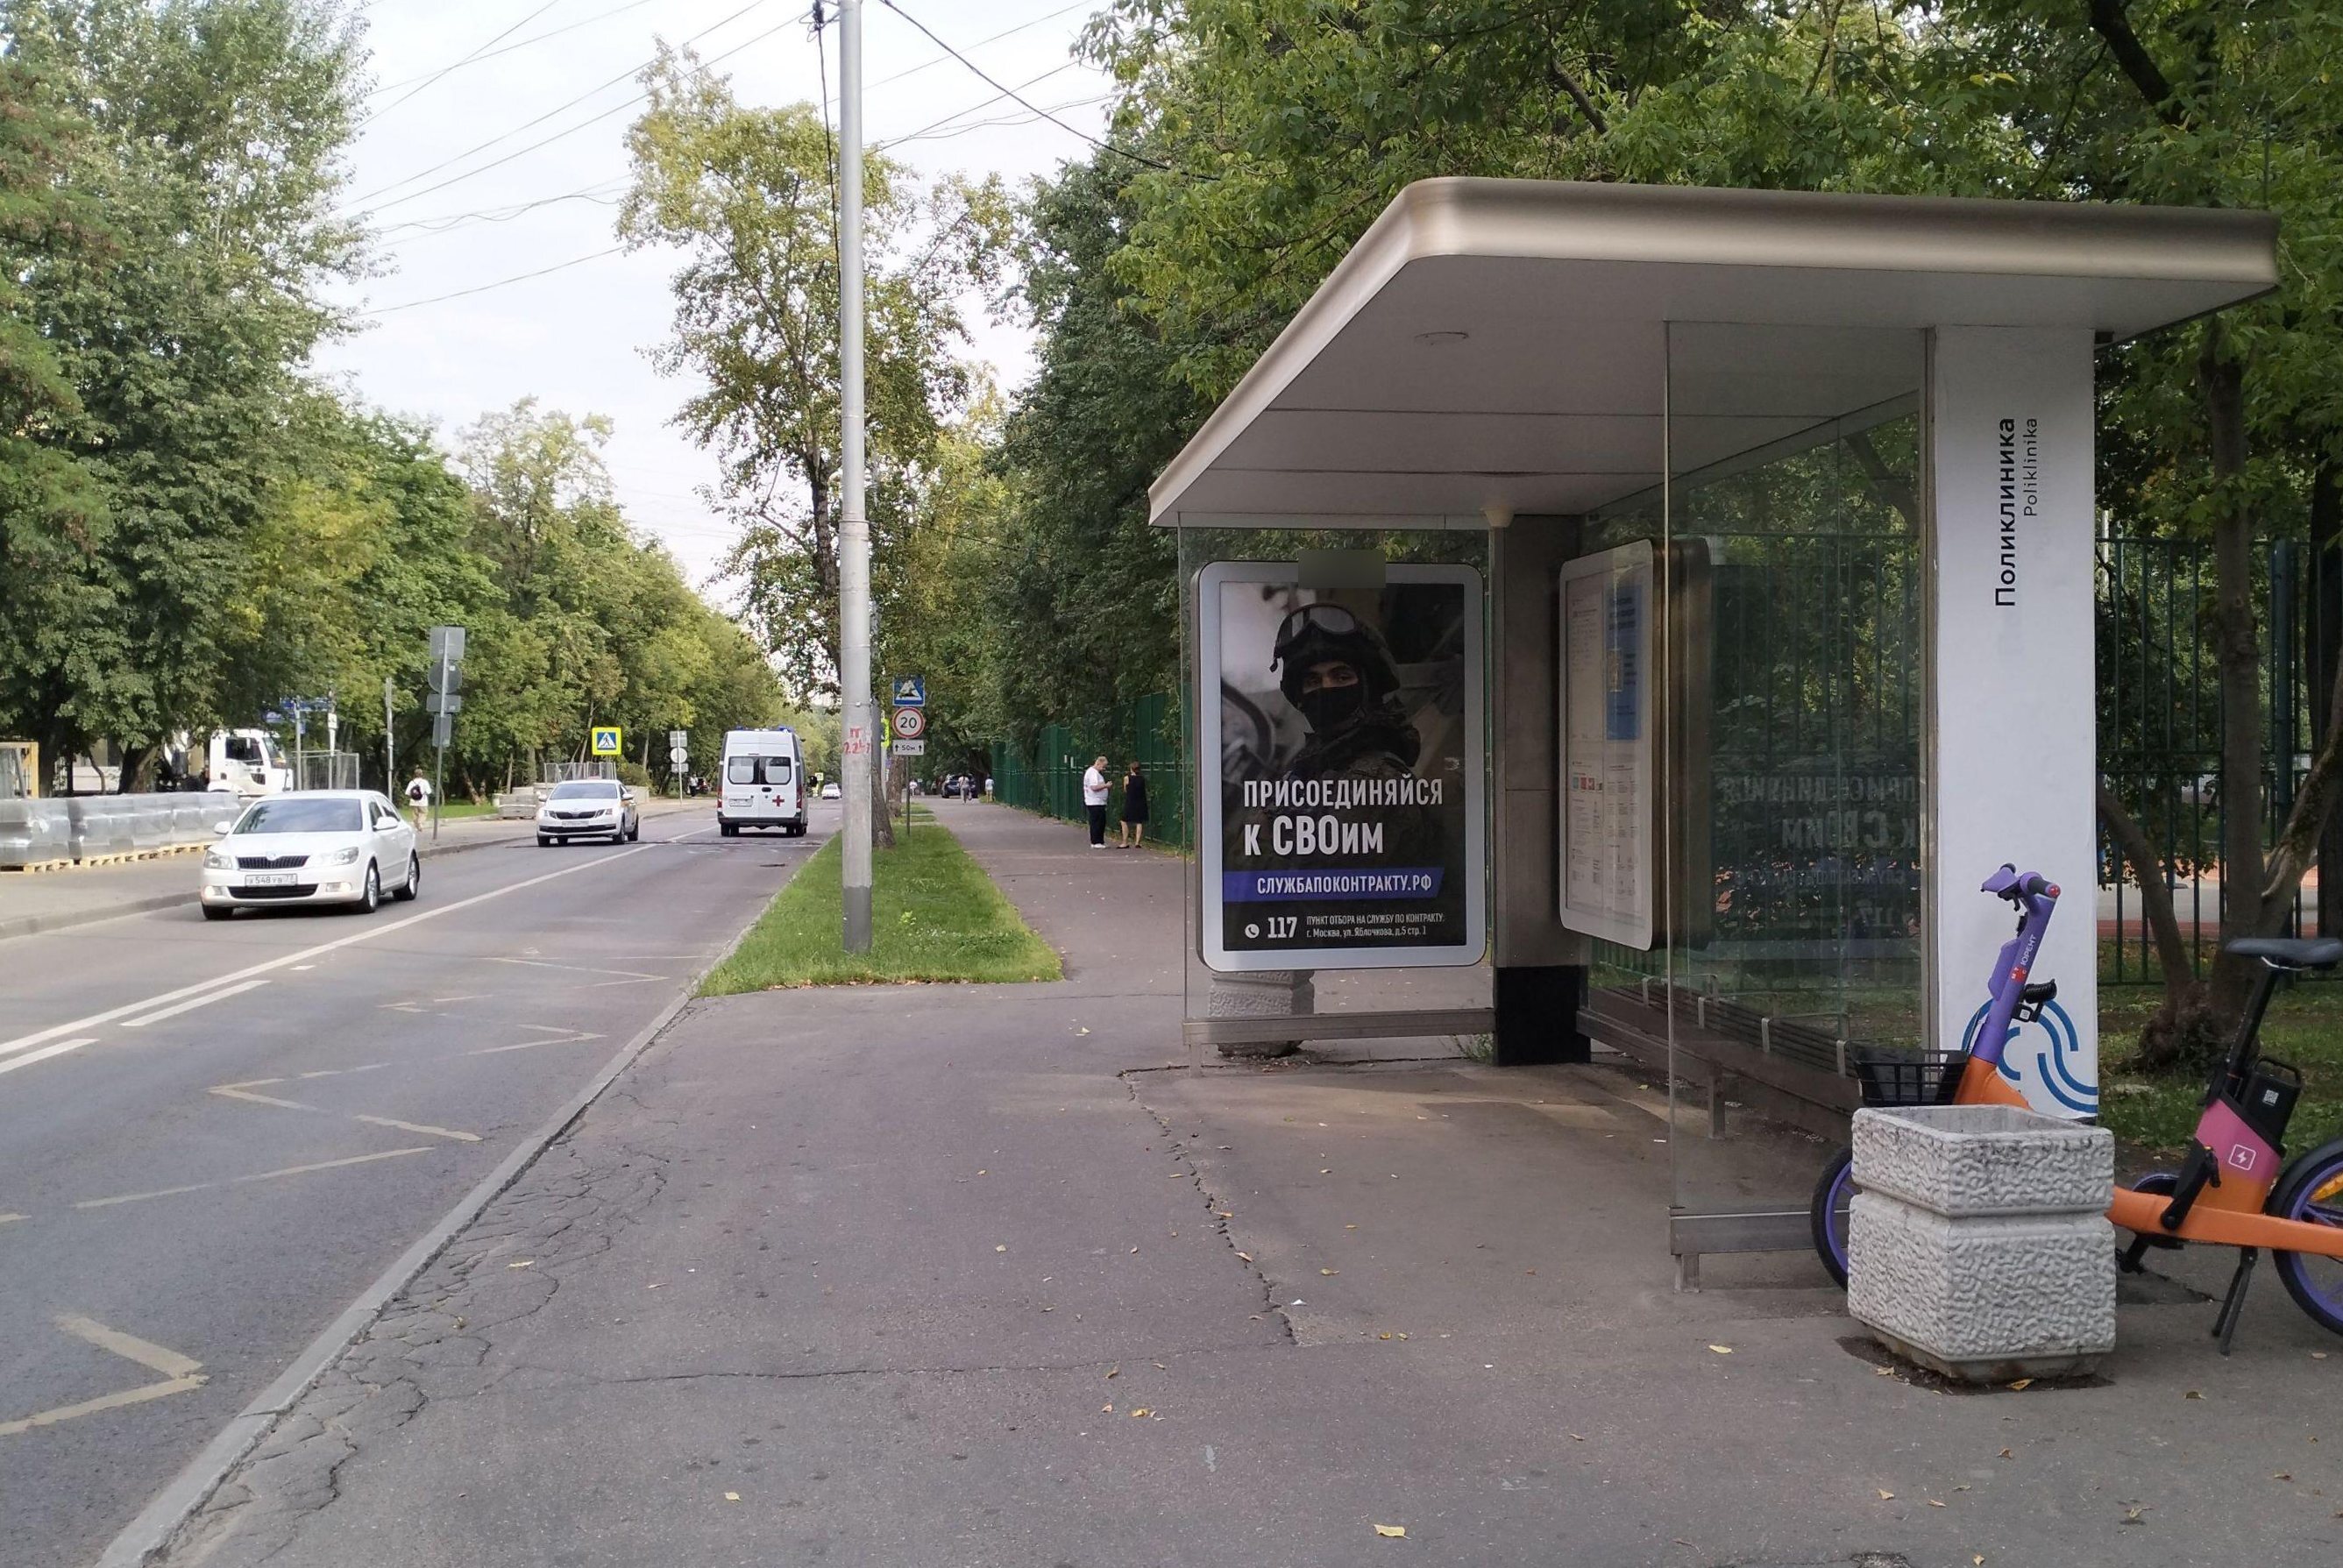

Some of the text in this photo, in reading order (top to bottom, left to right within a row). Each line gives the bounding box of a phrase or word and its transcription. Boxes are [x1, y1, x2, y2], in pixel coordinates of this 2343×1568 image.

[2023, 418, 2037, 516] Poliklinika
[1995, 418, 2015, 607] Поликлиника
[900, 717, 917, 728] 20
[1243, 773, 1443, 810] ПРИСОЕДИНЯЙСЯ
[1257, 874, 1432, 895] СЛУЖБАПОКОНТРАКТУ.РФ
[1267, 917, 1297, 939] 117
[1306, 915, 1328, 926] ПУНКТ
[1329, 915, 1355, 925] ОТБОРА
[1356, 914, 1366, 924] НА
[1367, 914, 1394, 924] СЛУЖБУ
[1395, 913, 1404, 923] ПО
[1313, 928, 1342, 939] Москва,
[2020, 933, 2036, 966] ЮРЕНТ
